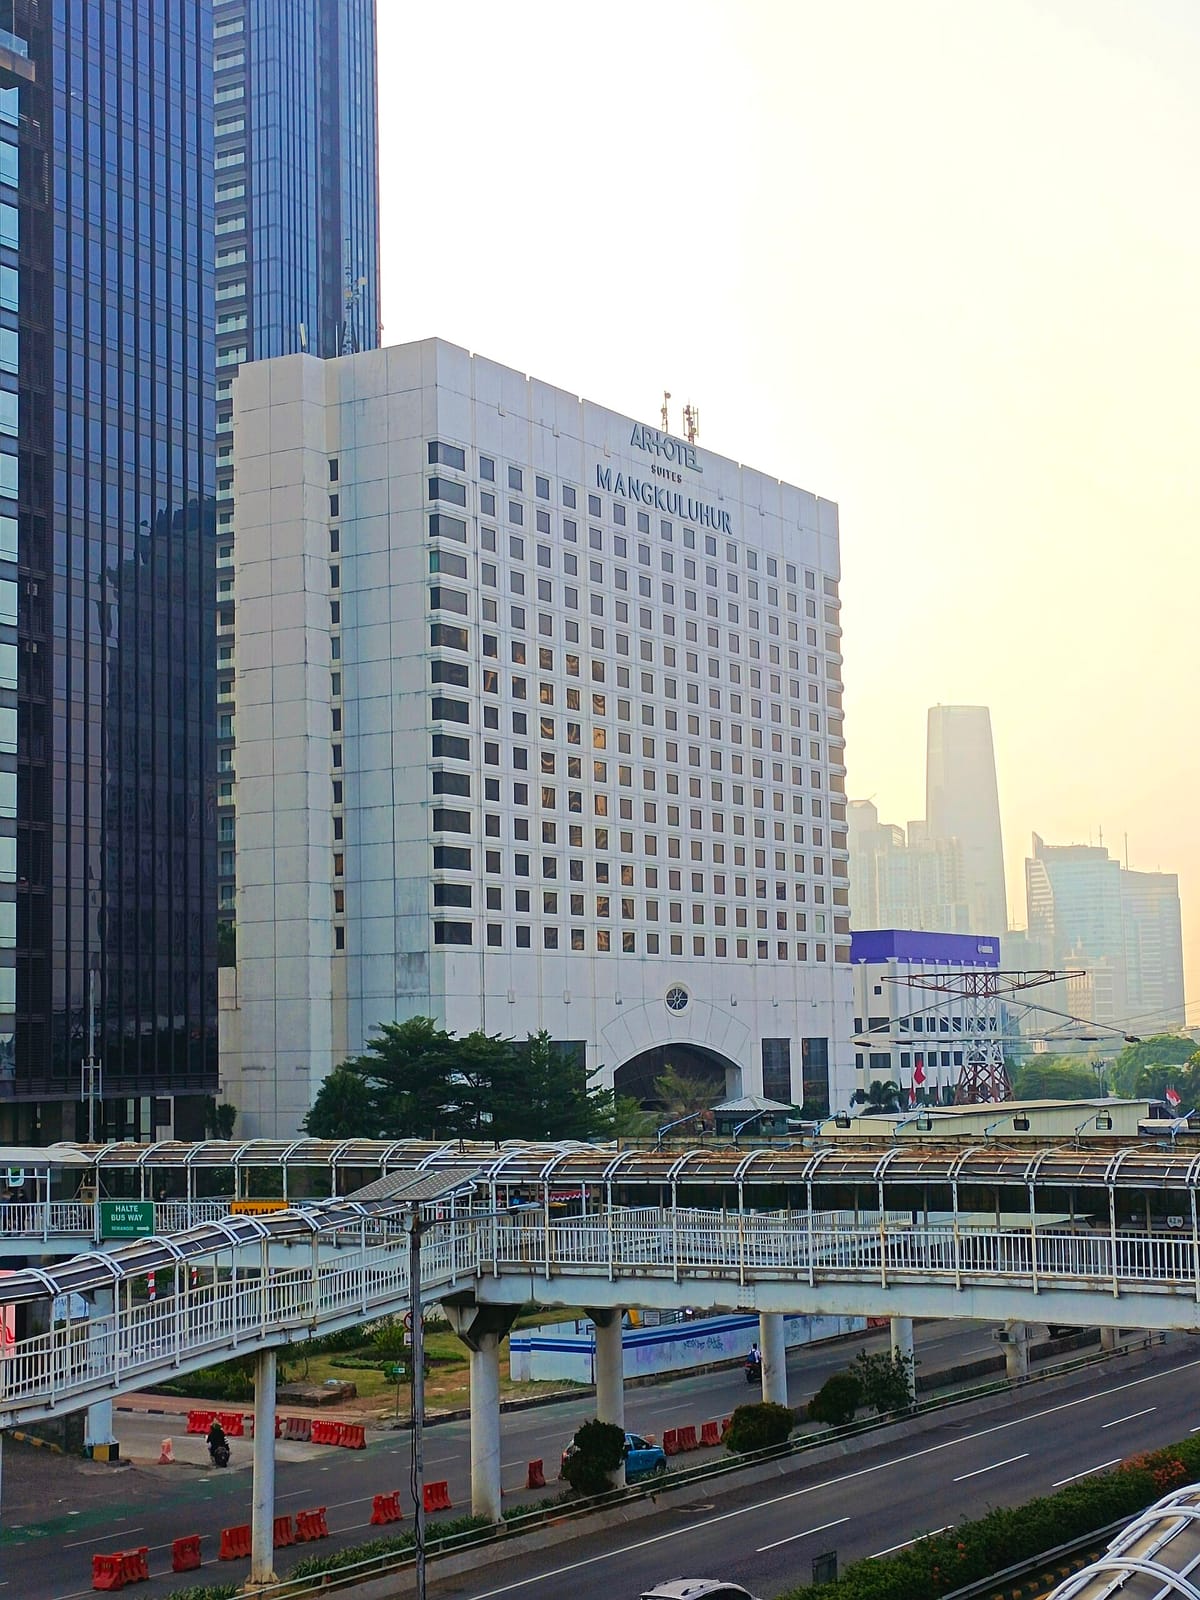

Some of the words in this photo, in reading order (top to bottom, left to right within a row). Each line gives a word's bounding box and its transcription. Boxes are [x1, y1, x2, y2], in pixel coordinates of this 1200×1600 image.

[651, 464, 682, 484] SUITES
[596, 463, 732, 535] MANGKULUHUR
[115, 1204, 139, 1213] HALTE
[110, 1214, 126, 1222] BUS
[127, 1214, 144, 1222] WAY
